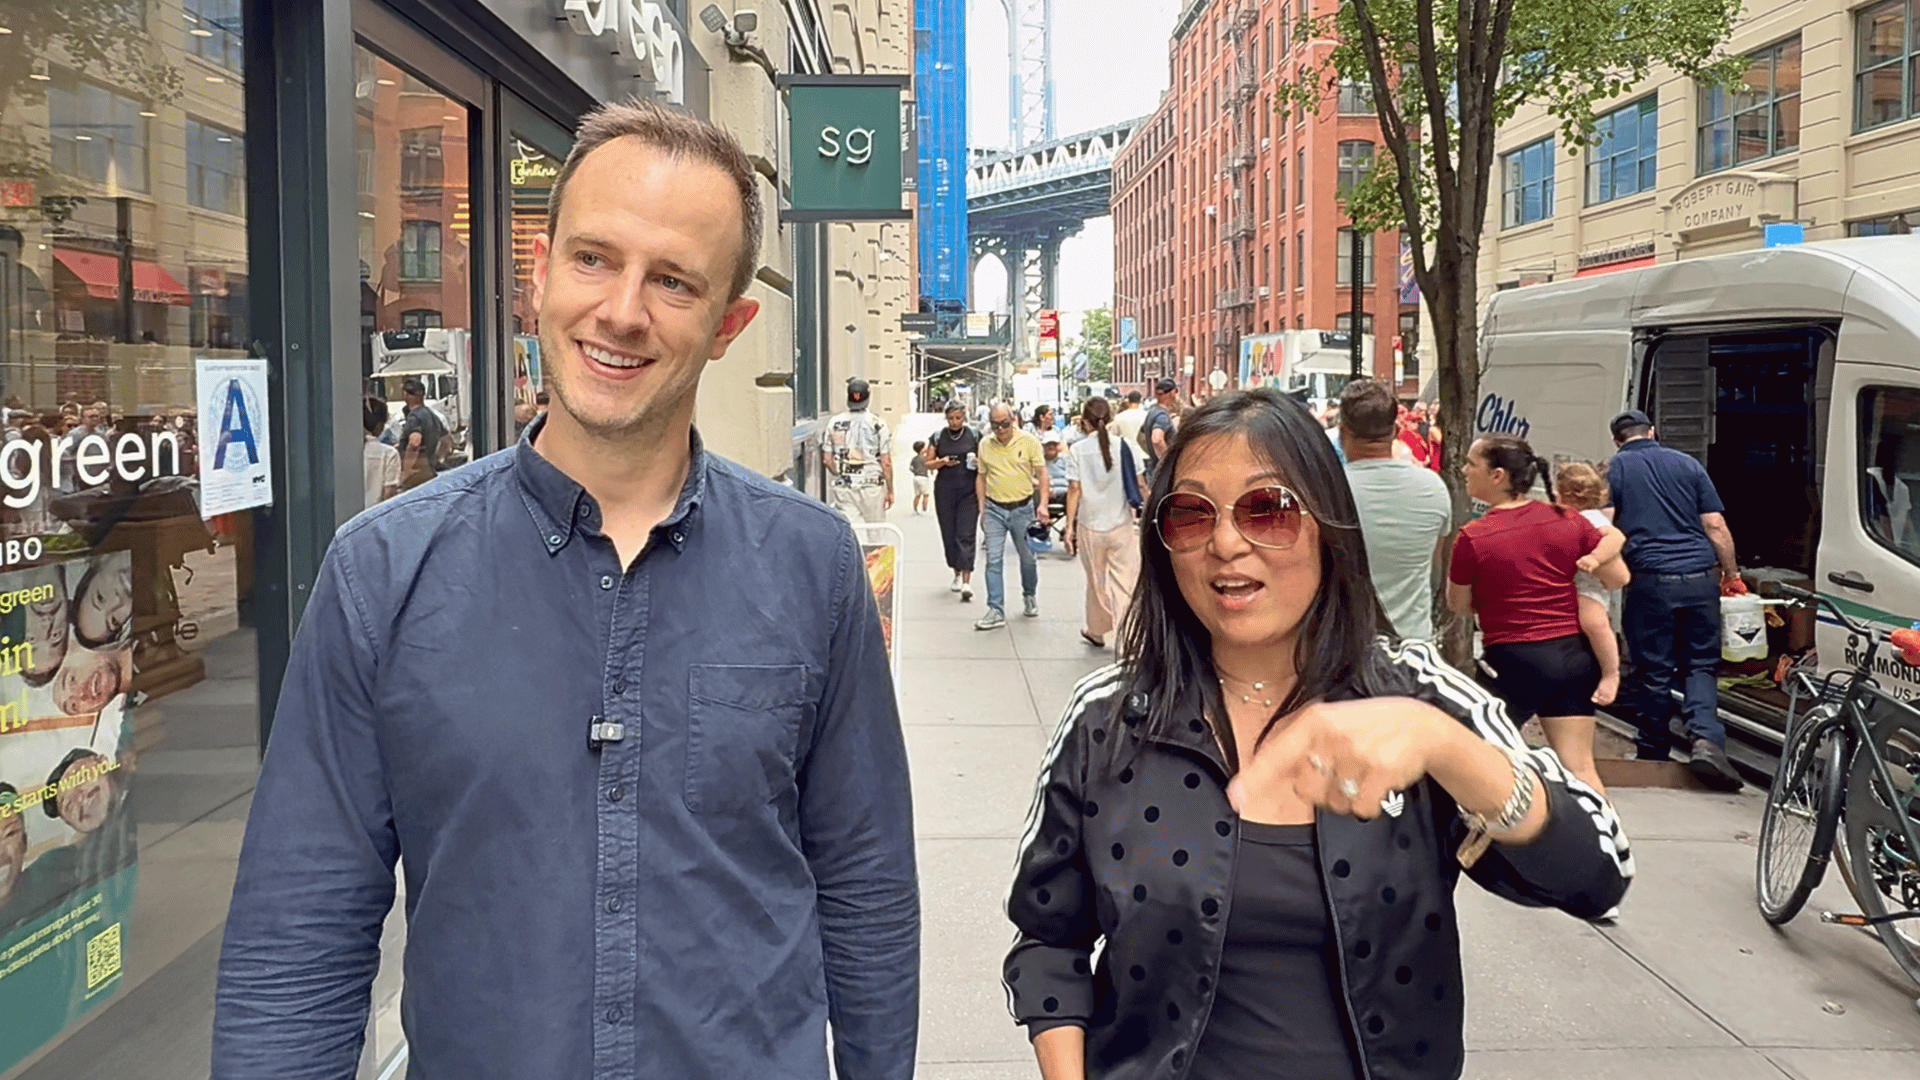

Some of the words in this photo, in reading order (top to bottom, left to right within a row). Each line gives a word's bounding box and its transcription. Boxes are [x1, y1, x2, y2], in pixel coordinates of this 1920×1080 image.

[818, 126, 876, 164] sg
[1675, 183, 1722, 213] ROBERT
[1726, 181, 1755, 198] GAIR
[1685, 204, 1743, 227] COMPANY
[213, 379, 259, 470] A
[0, 431, 180, 509] green
[0, 537, 42, 566] BO
[0, 584, 54, 614] green
[0, 635, 36, 677] in
[1893, 685, 1911, 701] US
[0, 803, 12, 818] e
[13, 783, 57, 813] starts
[59, 765, 91, 793] with
